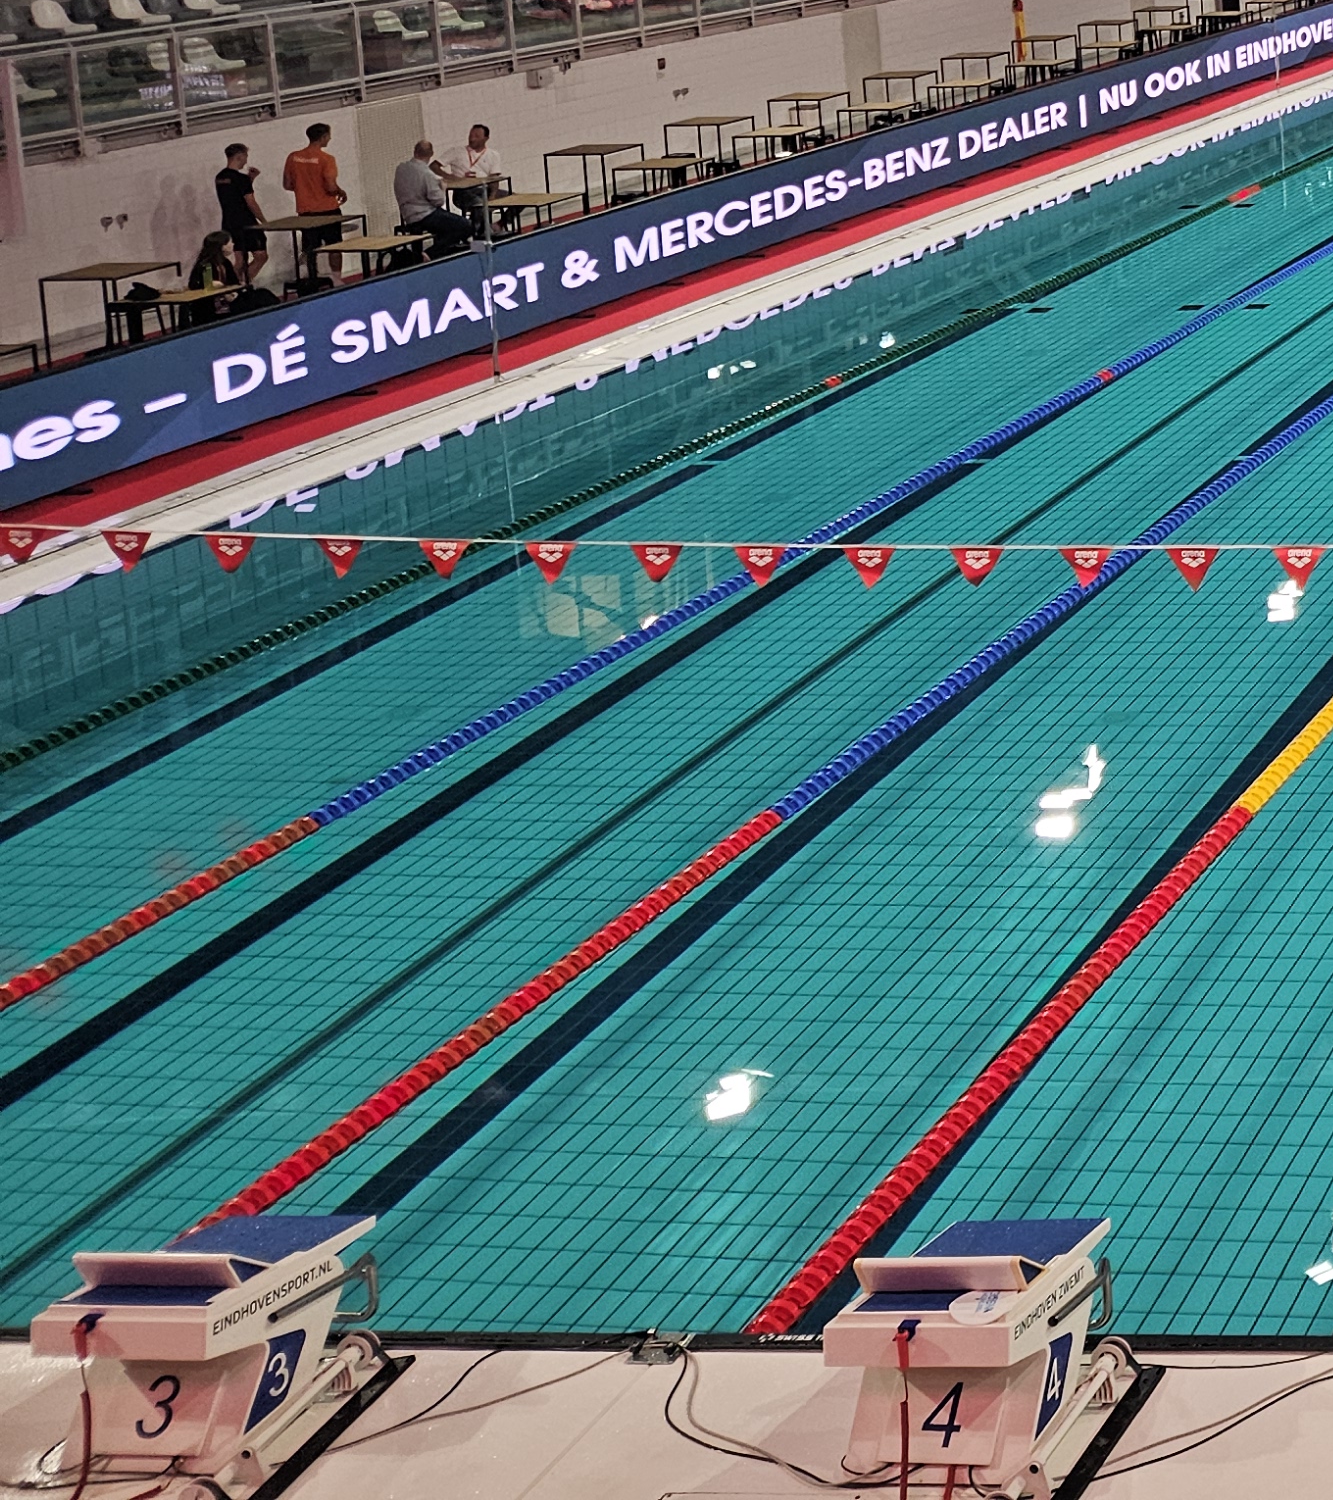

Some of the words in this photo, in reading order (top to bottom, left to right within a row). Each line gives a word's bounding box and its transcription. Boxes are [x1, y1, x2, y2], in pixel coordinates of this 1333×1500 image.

[212, 322, 309, 404] DÉ
[331, 261, 545, 364] SMART
[560, 249, 599, 288] &
[614, 129, 952, 271] MERCEDES-BENZ
[957, 102, 1068, 161] DEALER
[1098, 77, 1138, 114] NU
[1143, 60, 1201, 99] OOK
[1205, 50, 1231, 79] IN
[218, 537, 242, 546] arena
[433, 542, 458, 550] arena
[539, 543, 564, 552] arena
[646, 546, 669, 555] arena
[748, 547, 773, 557] arena
[1287, 548, 1312, 557] arena
[858, 548, 882, 558] arena
[965, 550, 989, 559] arena
[1074, 550, 1098, 559] arena
[1181, 548, 1205, 558] arena
[212, 1259, 334, 1337] EINDHOVENSPORT.NL
[1014, 1290, 1057, 1341] EINDHOVEN
[268, 1356, 290, 1398] 3
[1046, 1358, 1061, 1402] 4
[135, 1375, 181, 1439] 3
[921, 1382, 964, 1448] 4
